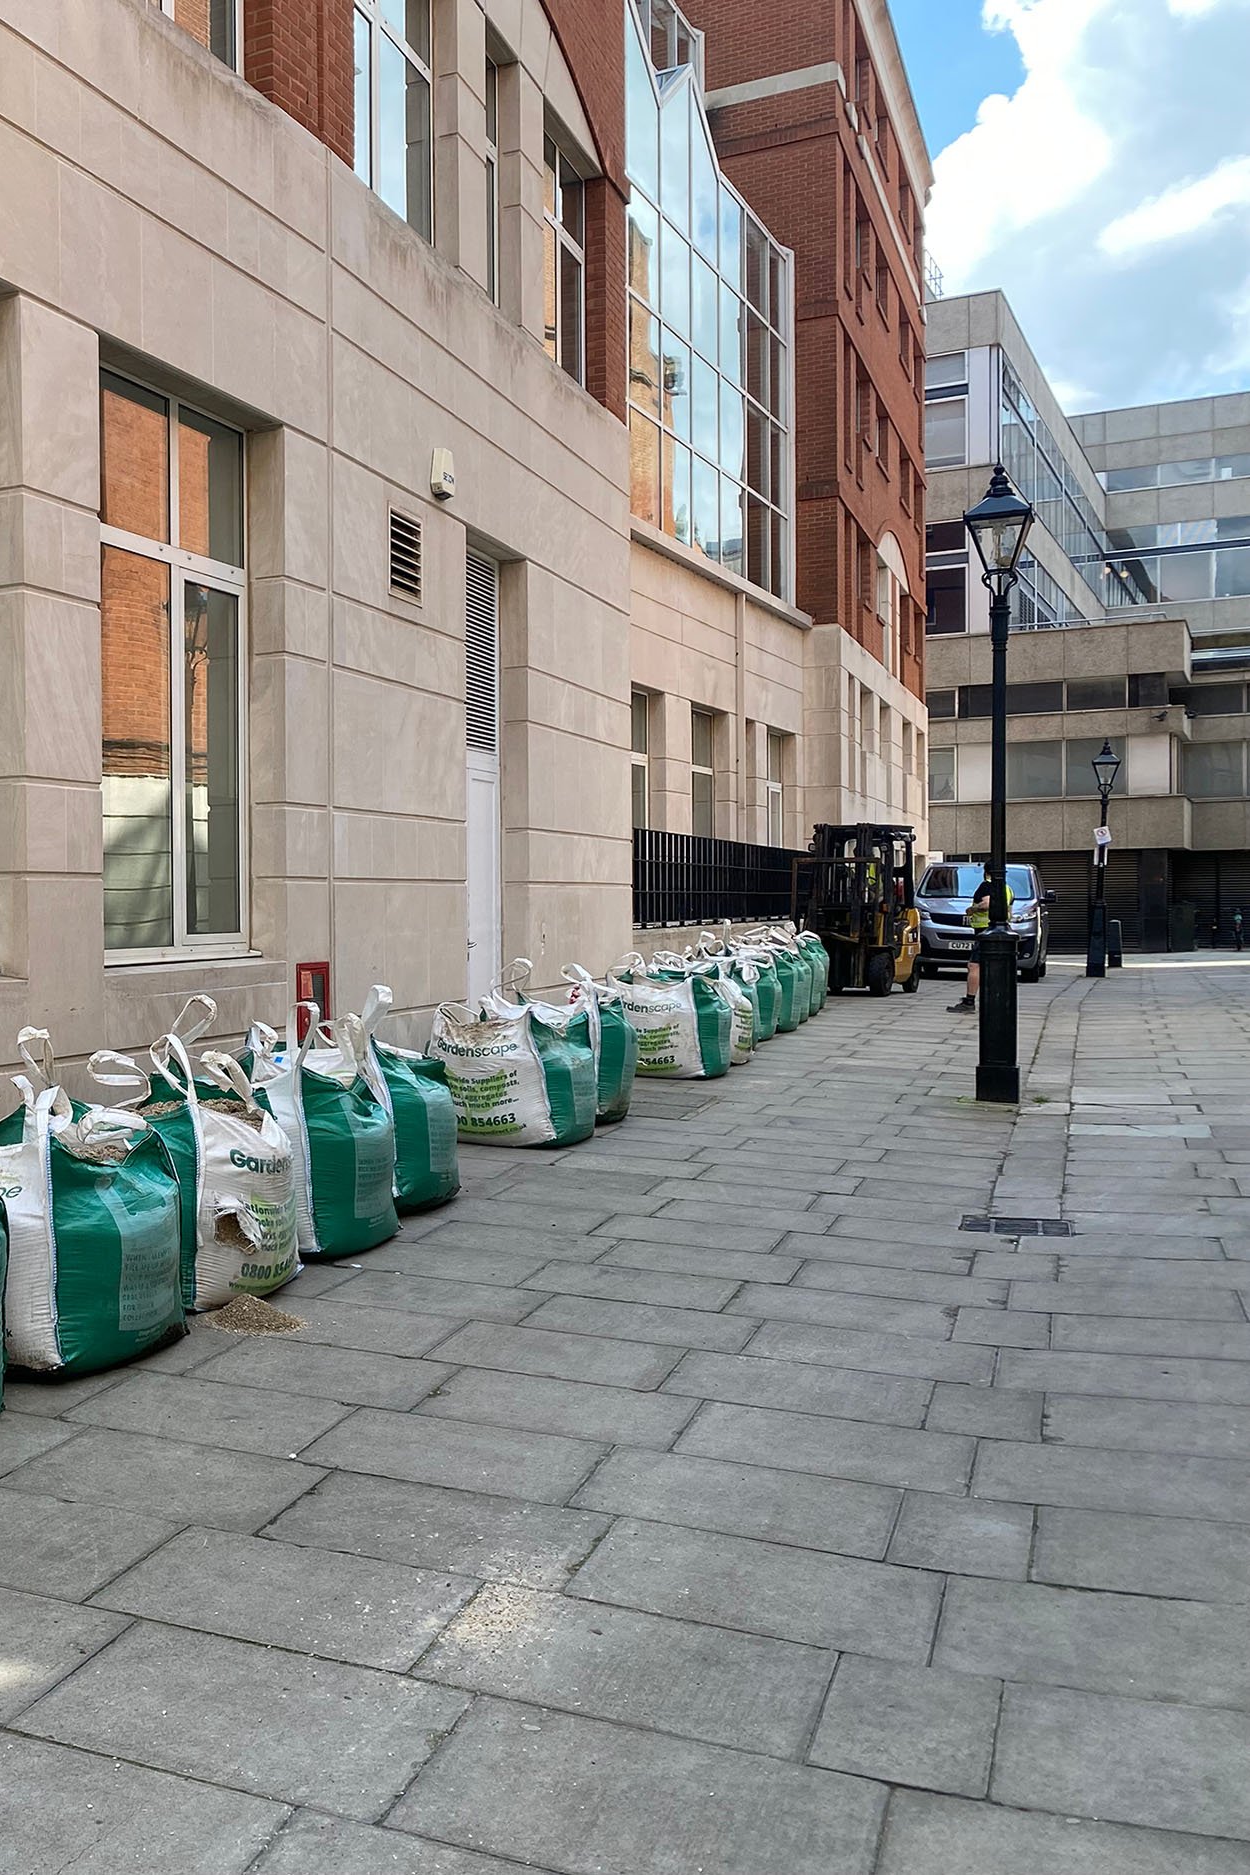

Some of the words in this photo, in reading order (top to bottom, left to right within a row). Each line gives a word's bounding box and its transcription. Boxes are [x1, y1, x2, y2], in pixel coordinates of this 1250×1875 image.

[622, 1001, 682, 1013] rdenscape
[437, 1037, 518, 1058] Gardenscape
[471, 1074, 508, 1085] Suppliers
[509, 1070, 517, 1078] of
[453, 1100, 467, 1108] uch
[470, 1112, 517, 1127] 854663
[230, 1149, 294, 1174] Garden
[241, 1263, 272, 1280] 0800
